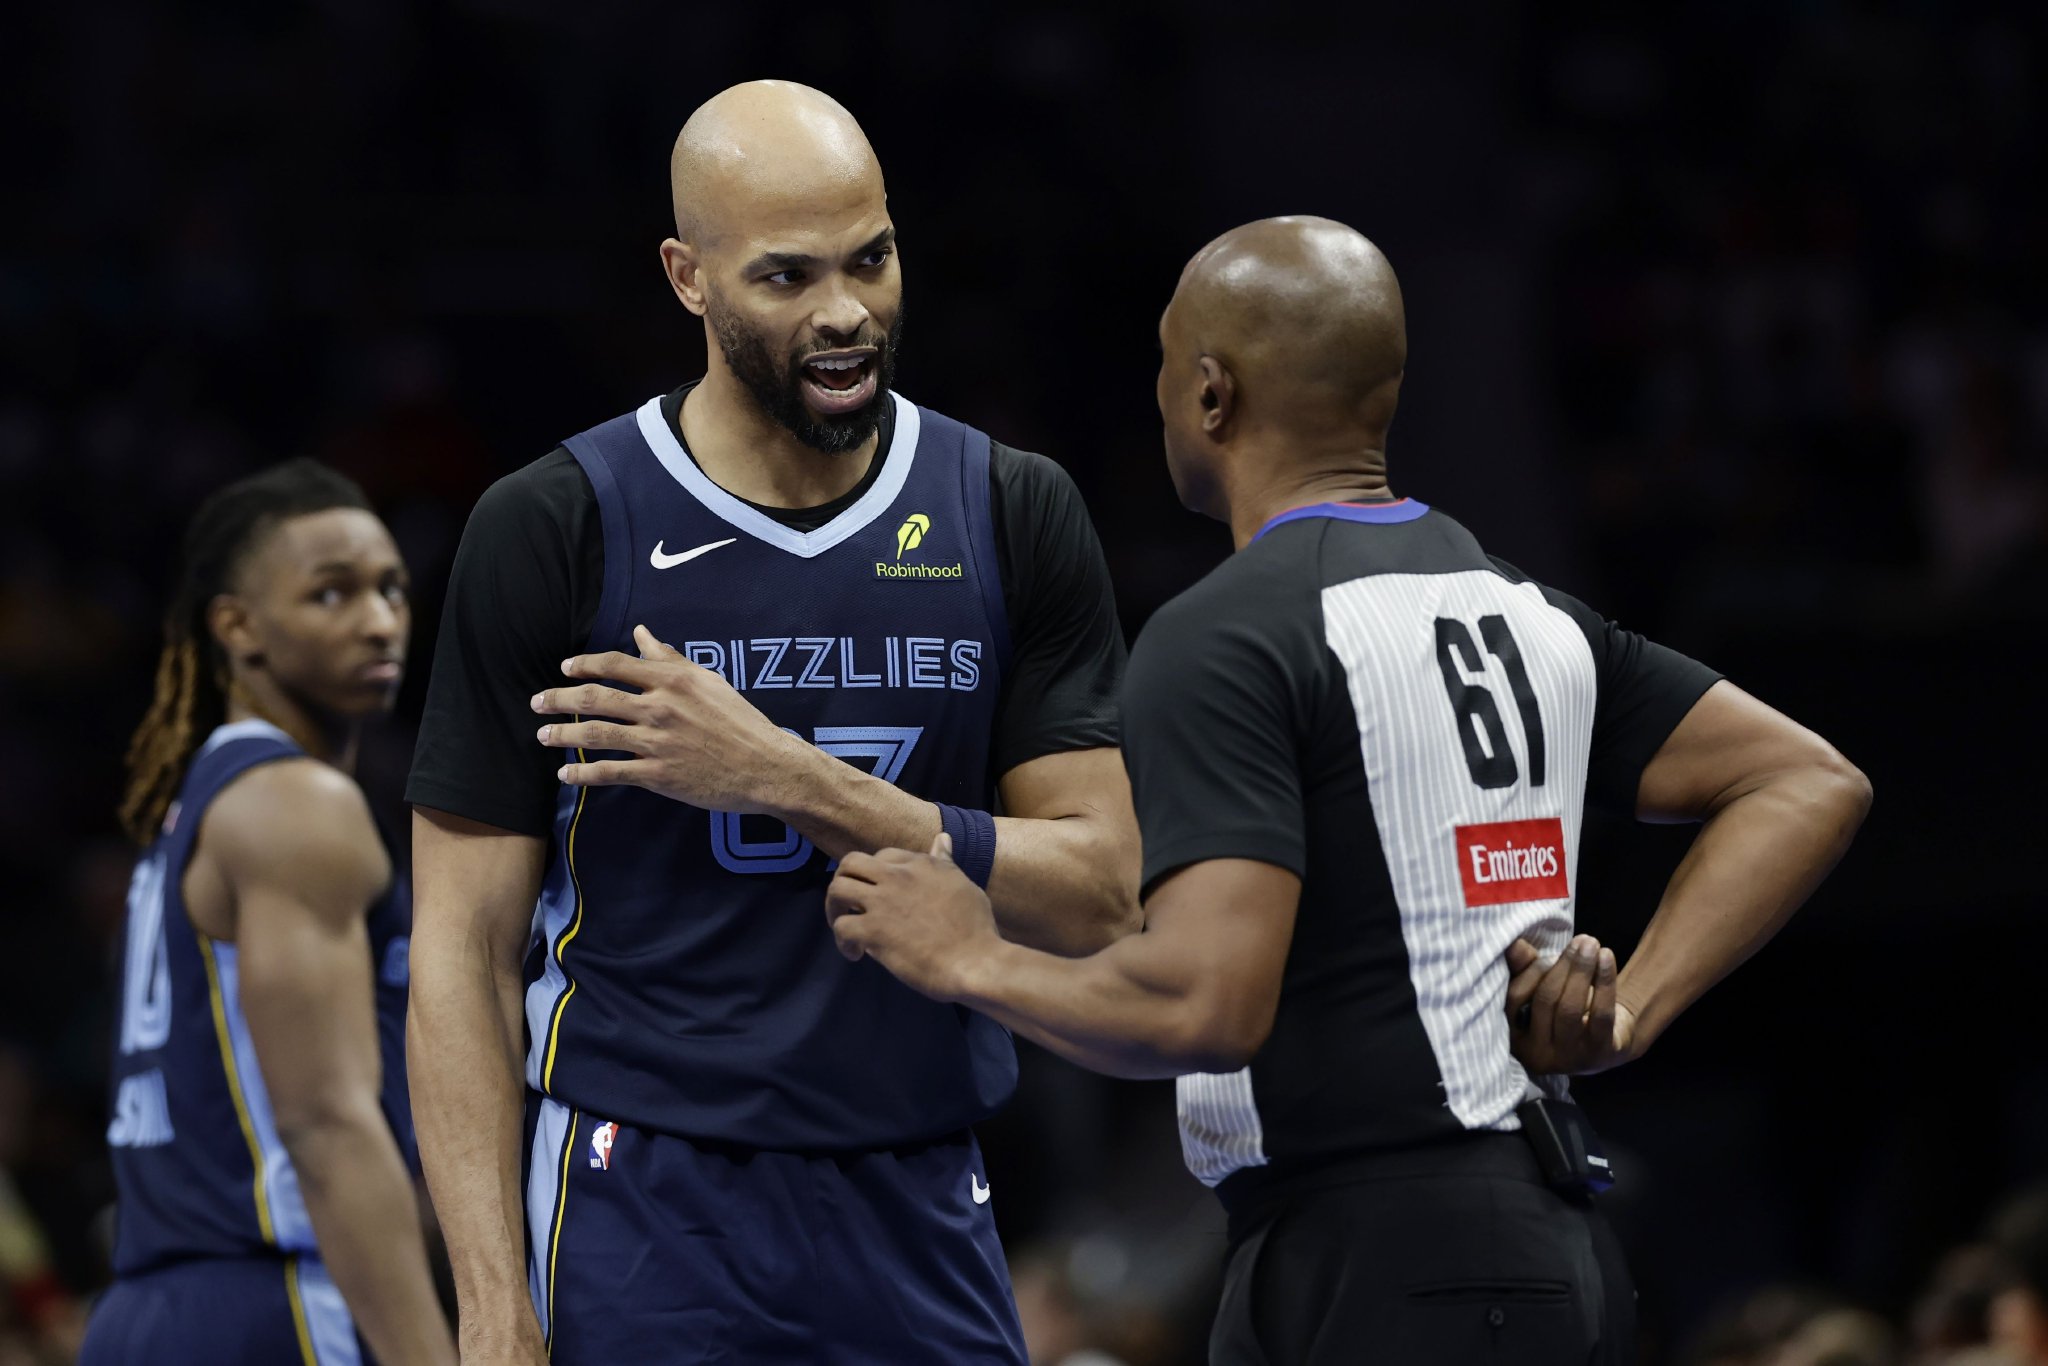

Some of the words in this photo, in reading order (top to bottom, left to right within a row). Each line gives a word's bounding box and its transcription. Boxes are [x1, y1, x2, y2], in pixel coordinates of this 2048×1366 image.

[875, 562, 962, 578] Robinhood
[640, 637, 982, 691] RIZZLIES
[1433, 614, 1546, 790] 61
[1469, 841, 1558, 884] Emirates
